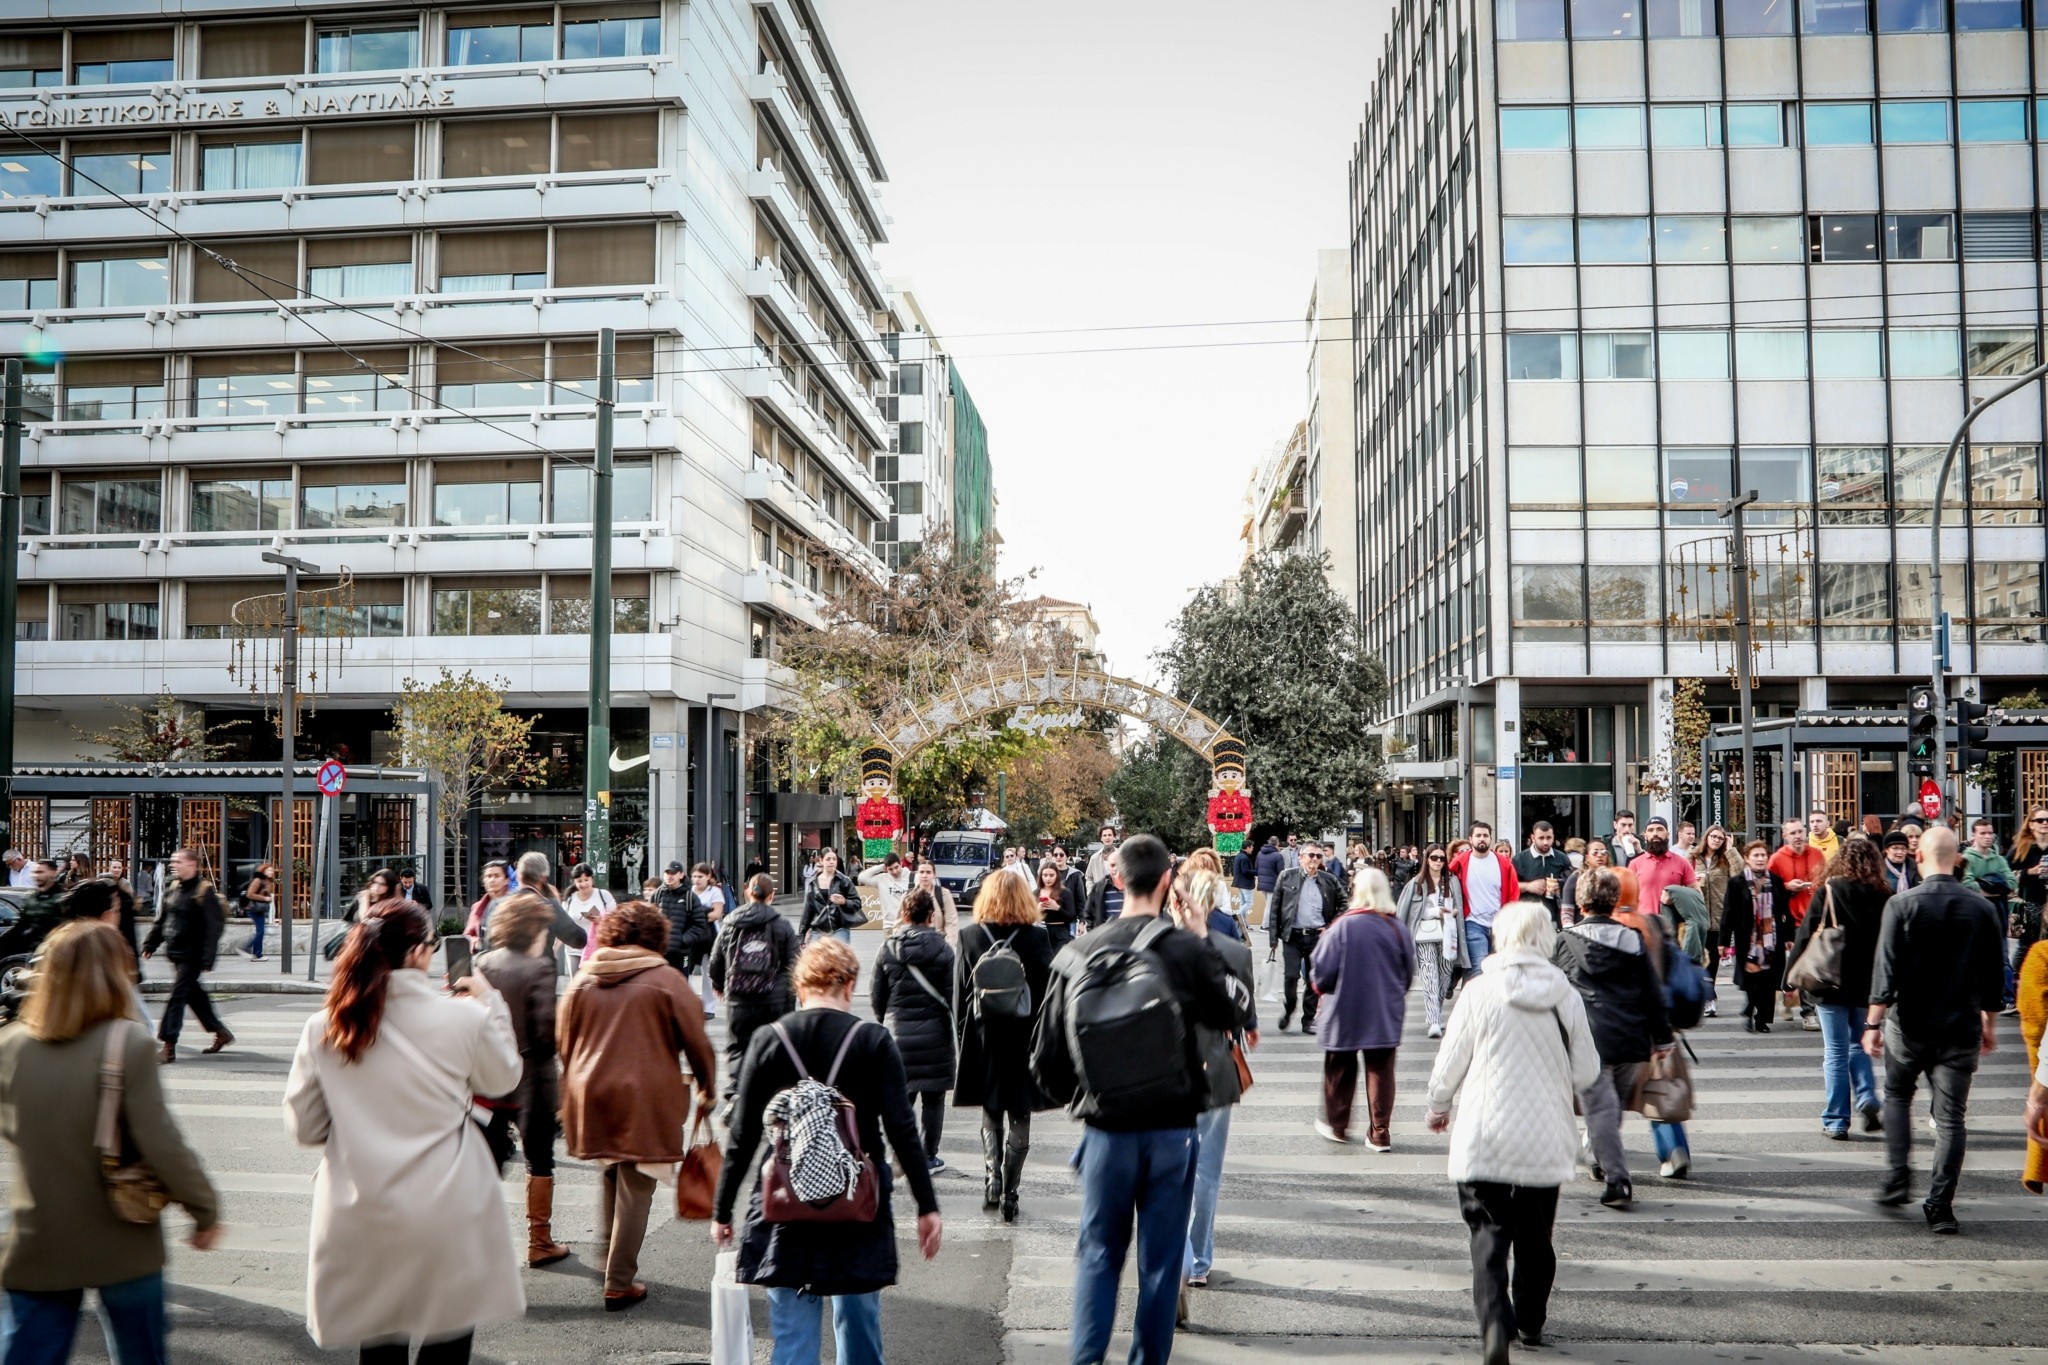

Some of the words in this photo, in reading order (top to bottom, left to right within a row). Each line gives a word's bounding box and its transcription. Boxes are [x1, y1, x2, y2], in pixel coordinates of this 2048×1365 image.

[264, 99, 280, 115] &
[302, 89, 454, 113] ΝΑΥΤΙΛΙΑΣ
[1712, 788, 1722, 826] Donald's
